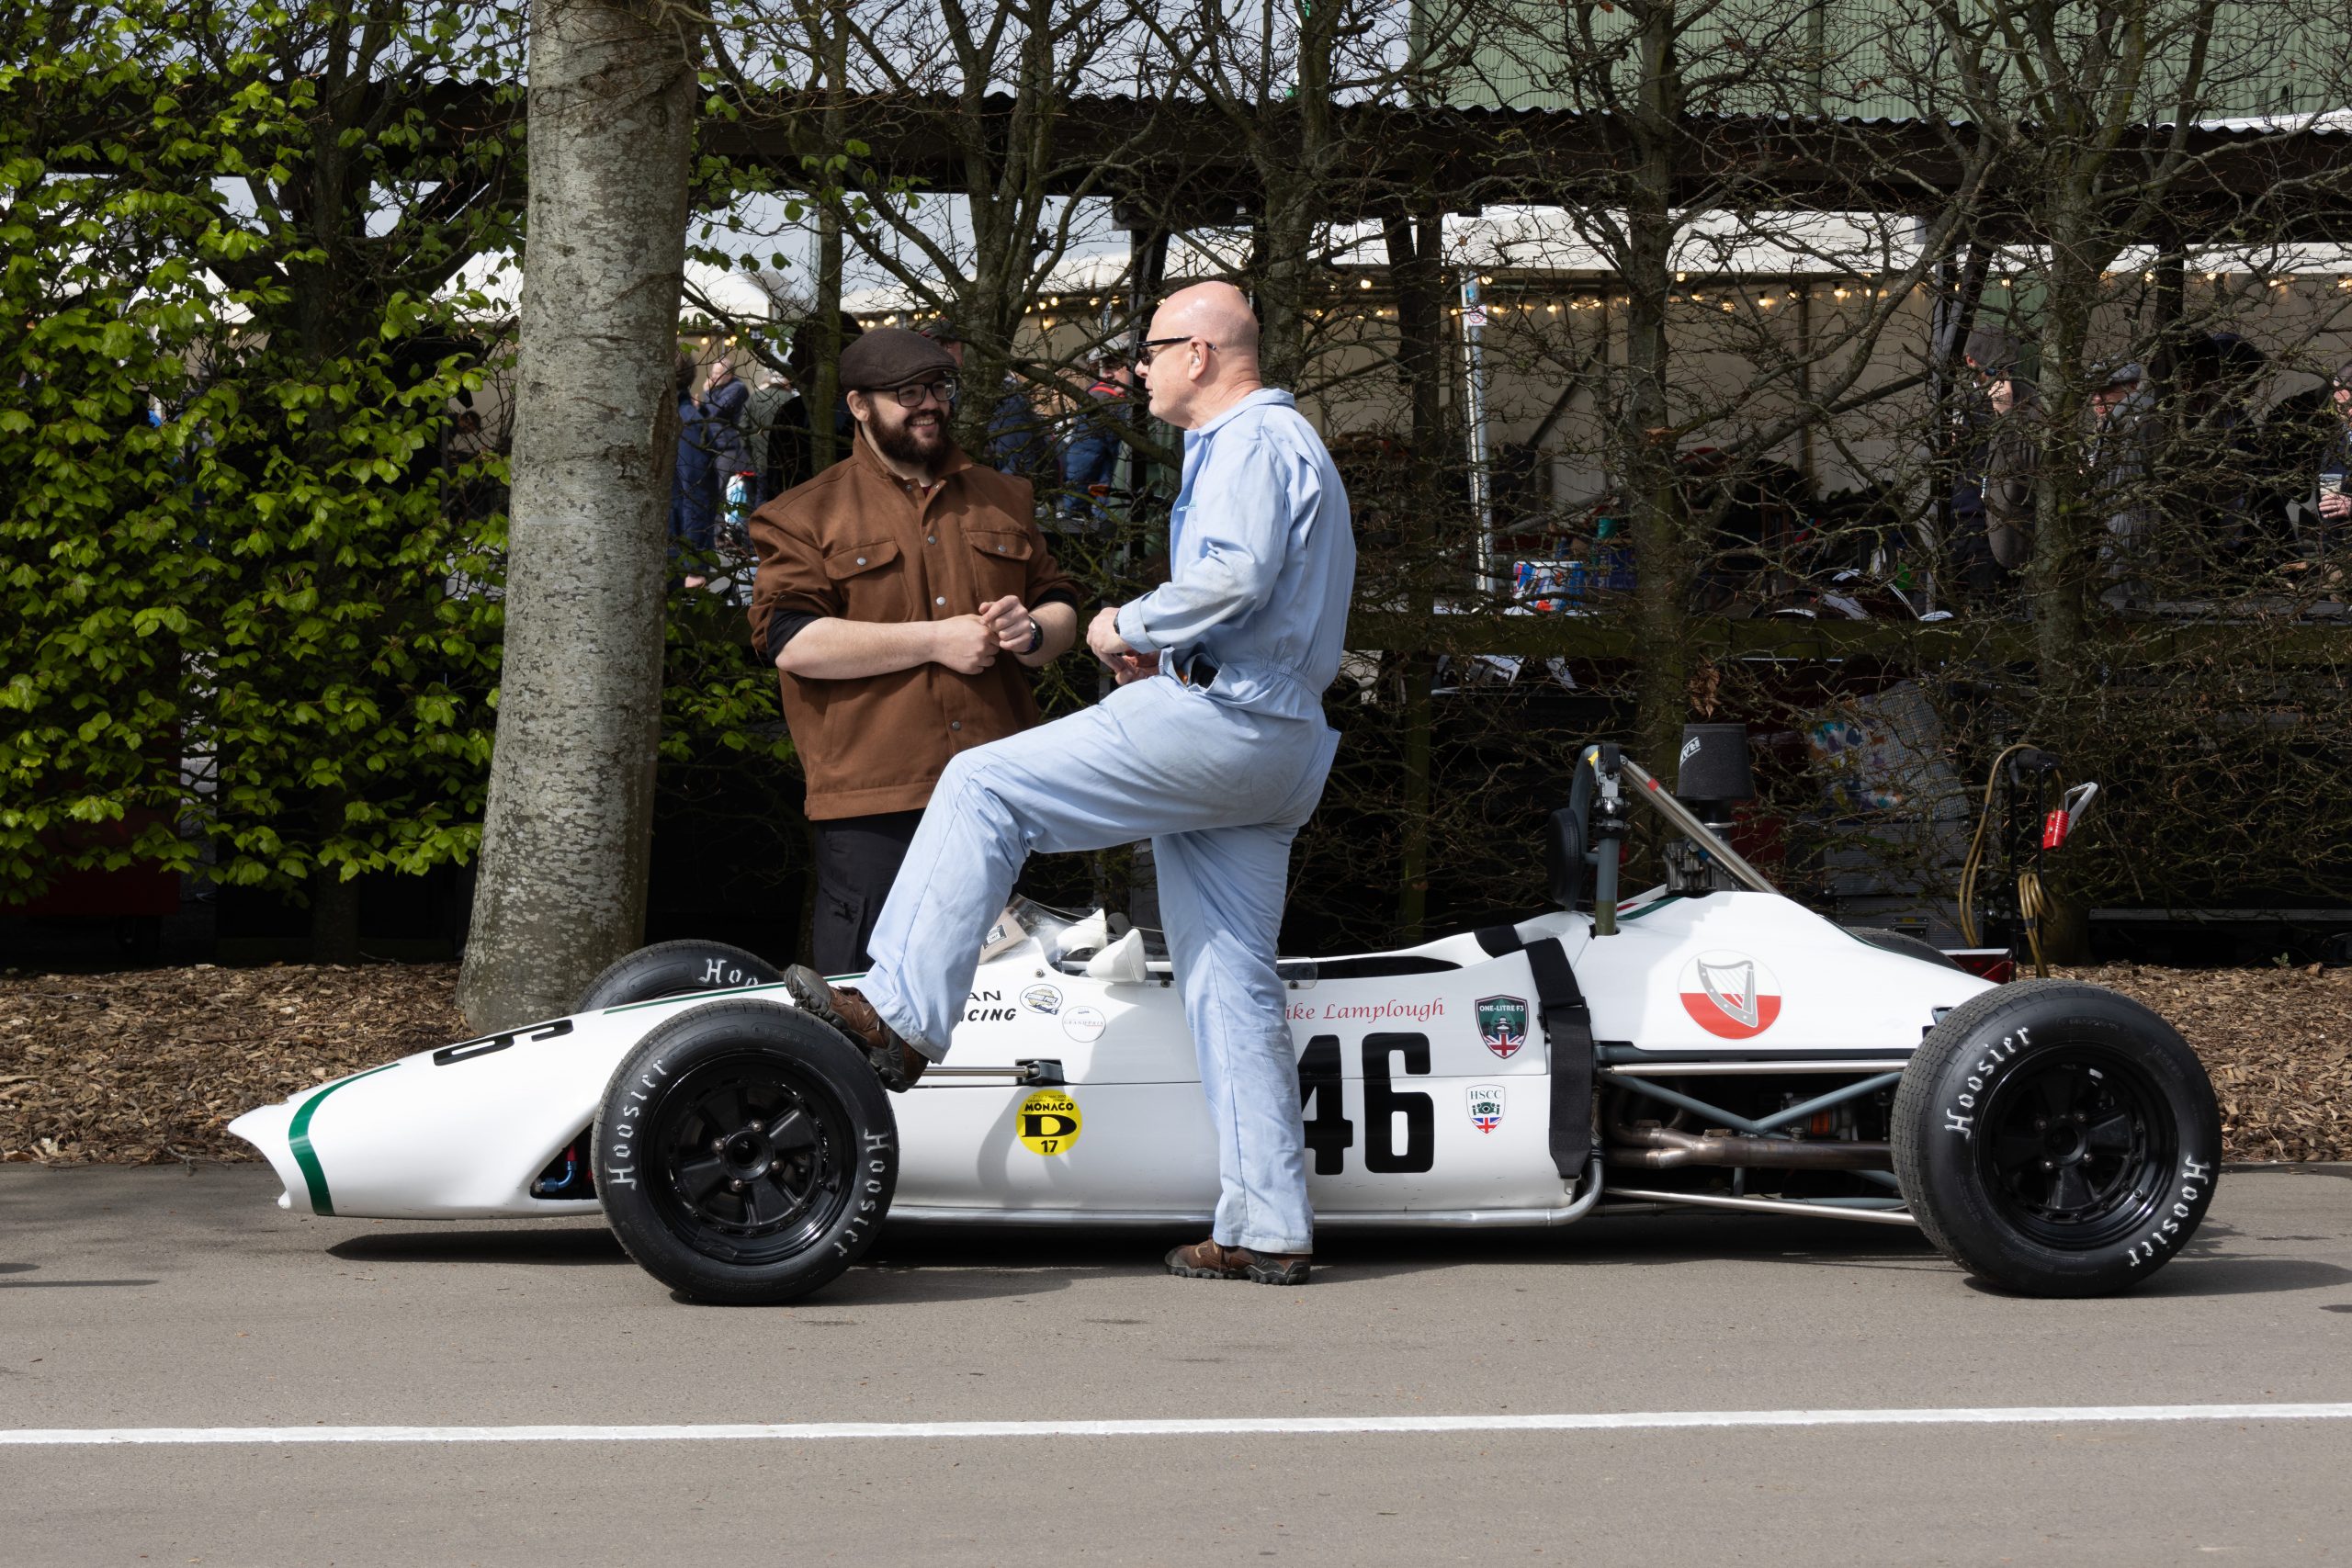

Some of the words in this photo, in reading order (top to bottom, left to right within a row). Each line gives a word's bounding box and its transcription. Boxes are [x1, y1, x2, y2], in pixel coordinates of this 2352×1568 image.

[967, 990, 1001, 1002] AN
[960, 1008, 1017, 1022] CING
[1286, 1002, 1316, 1020] ike
[1323, 998, 1445, 1024] Lamplough
[1470, 1089, 1501, 1100] HSCC
[1944, 1026, 2030, 1140] Hoosier
[1024, 1102, 1074, 1111] MONACO
[1297, 1032, 1435, 1176] 46
[605, 1057, 670, 1191] Hoosier
[1022, 1113, 1078, 1138] D
[1041, 1140, 1058, 1153] 17
[833, 1127, 890, 1258] Hoosier
[2128, 1152, 2210, 1268] Hoosier
